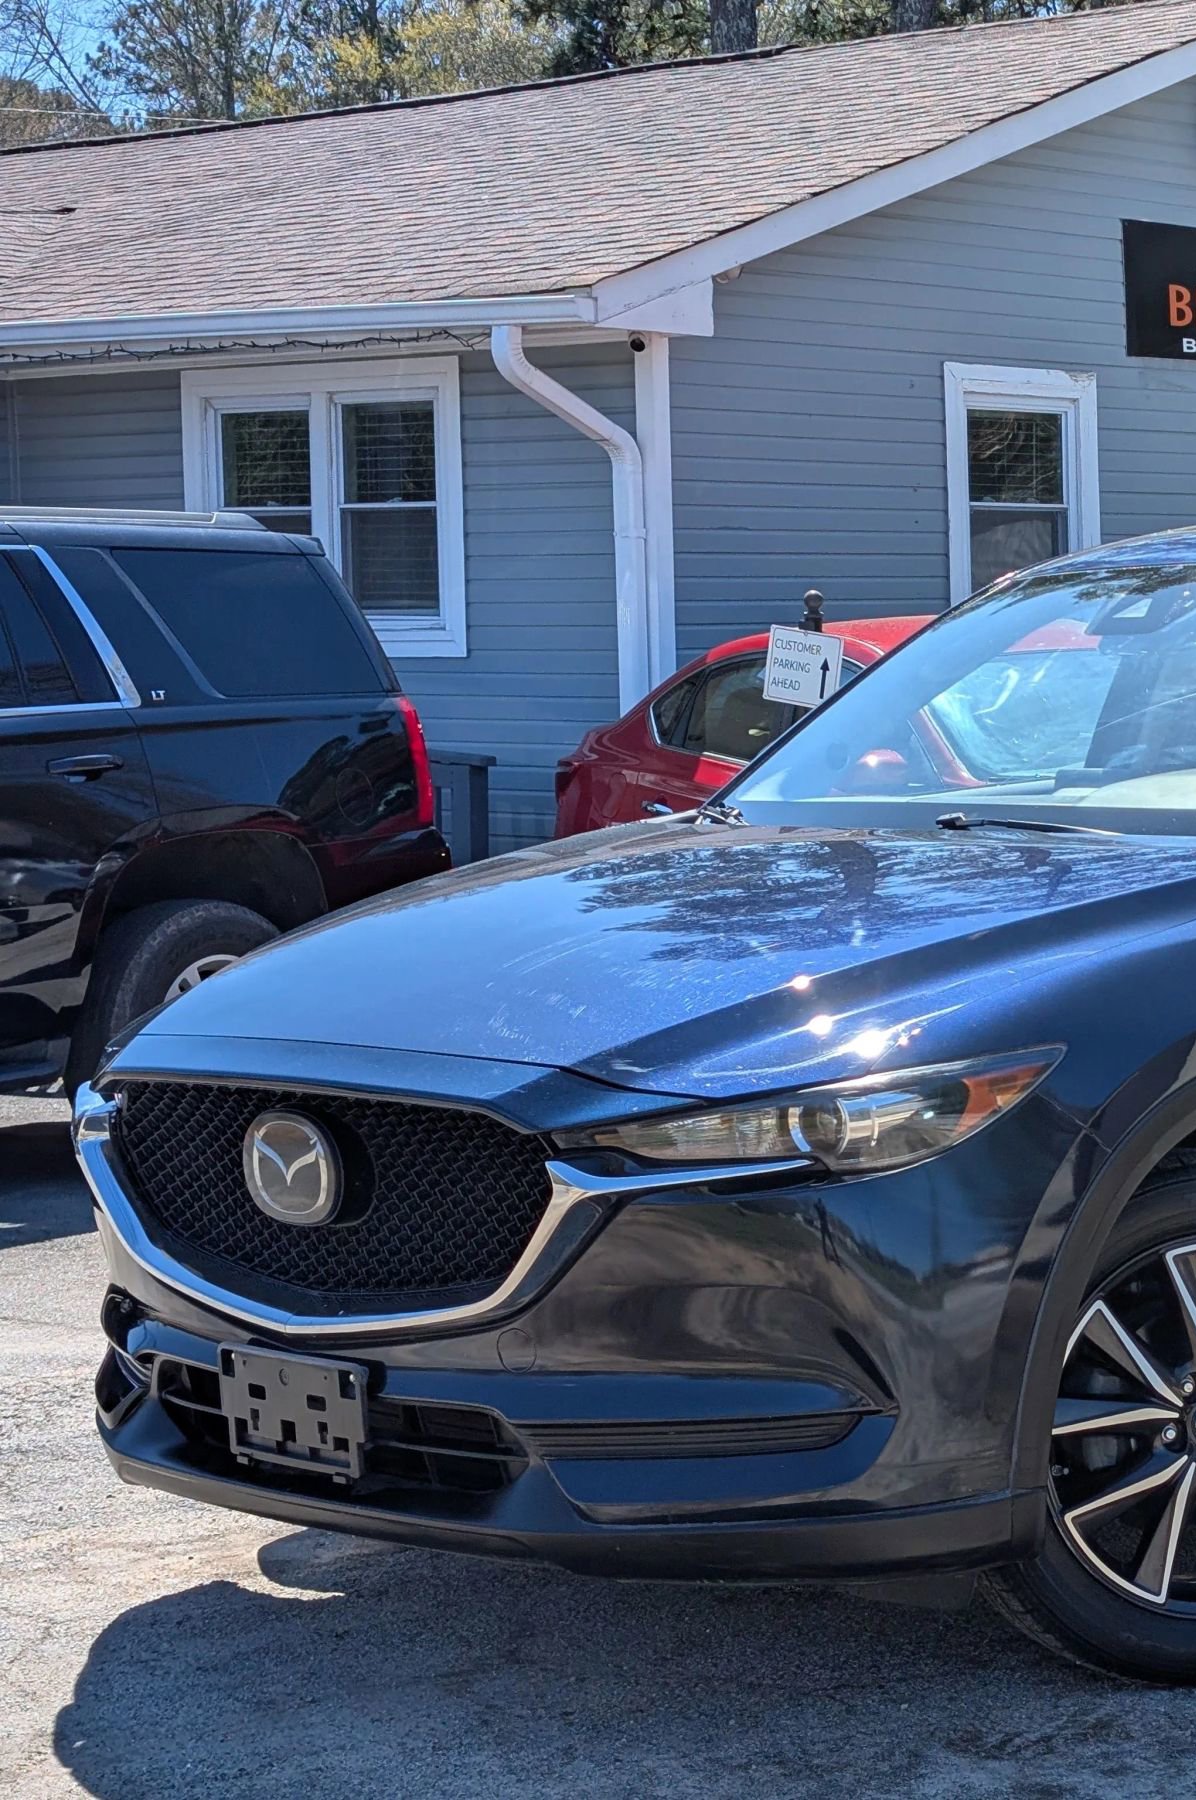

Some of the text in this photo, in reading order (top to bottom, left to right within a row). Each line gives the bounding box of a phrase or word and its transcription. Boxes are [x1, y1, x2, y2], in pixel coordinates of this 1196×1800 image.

[775, 638, 821, 655] CUSTOMER
[773, 657, 811, 673] PARKING
[770, 676, 801, 691] AHEAD
[151, 690, 165, 701] LT
